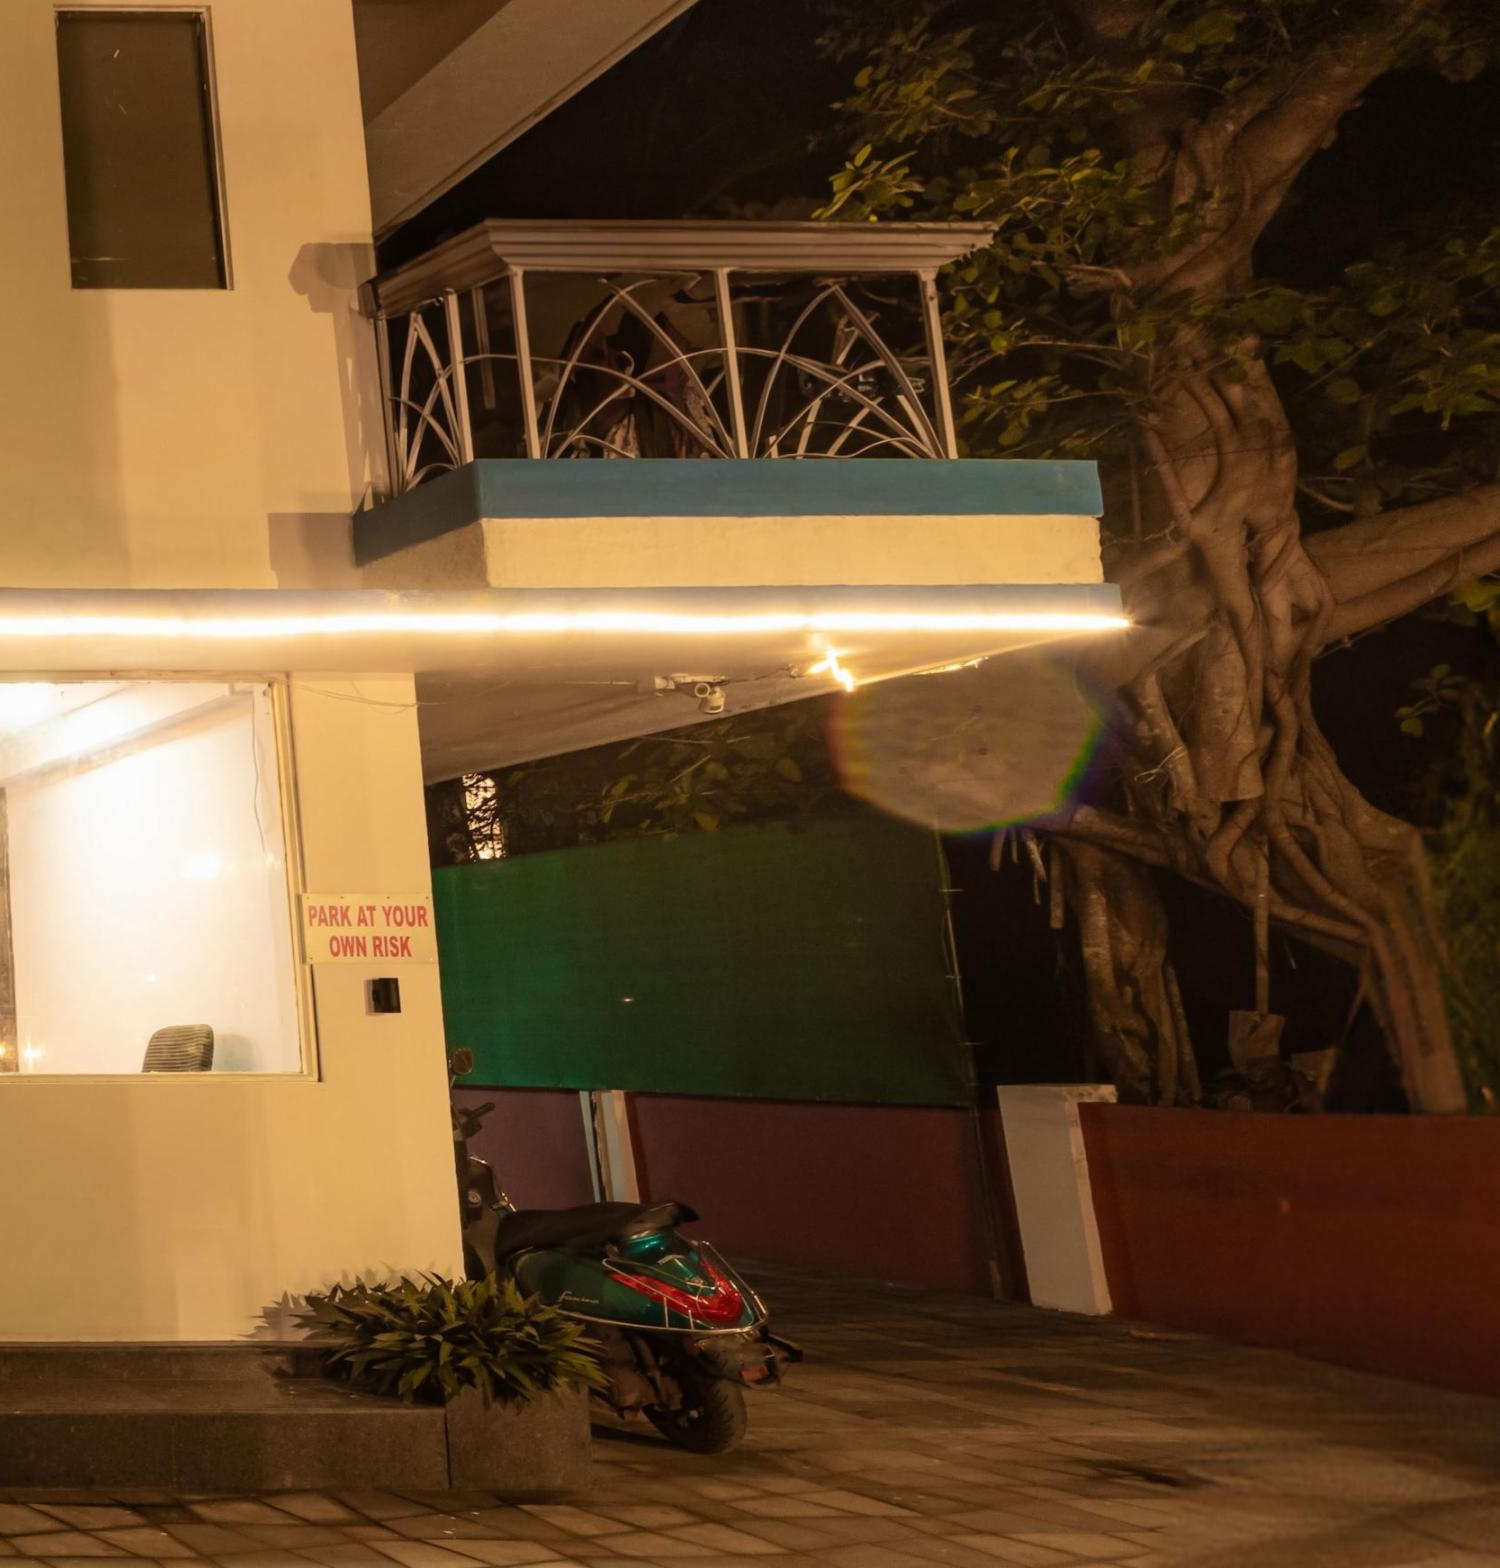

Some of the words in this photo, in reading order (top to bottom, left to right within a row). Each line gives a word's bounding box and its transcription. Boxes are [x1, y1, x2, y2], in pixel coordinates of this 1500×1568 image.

[308, 905, 352, 927] PARK
[357, 905, 377, 927] AT
[382, 906, 428, 927] YOUR
[329, 935, 367, 957] OWN
[372, 935, 412, 957] RISK
